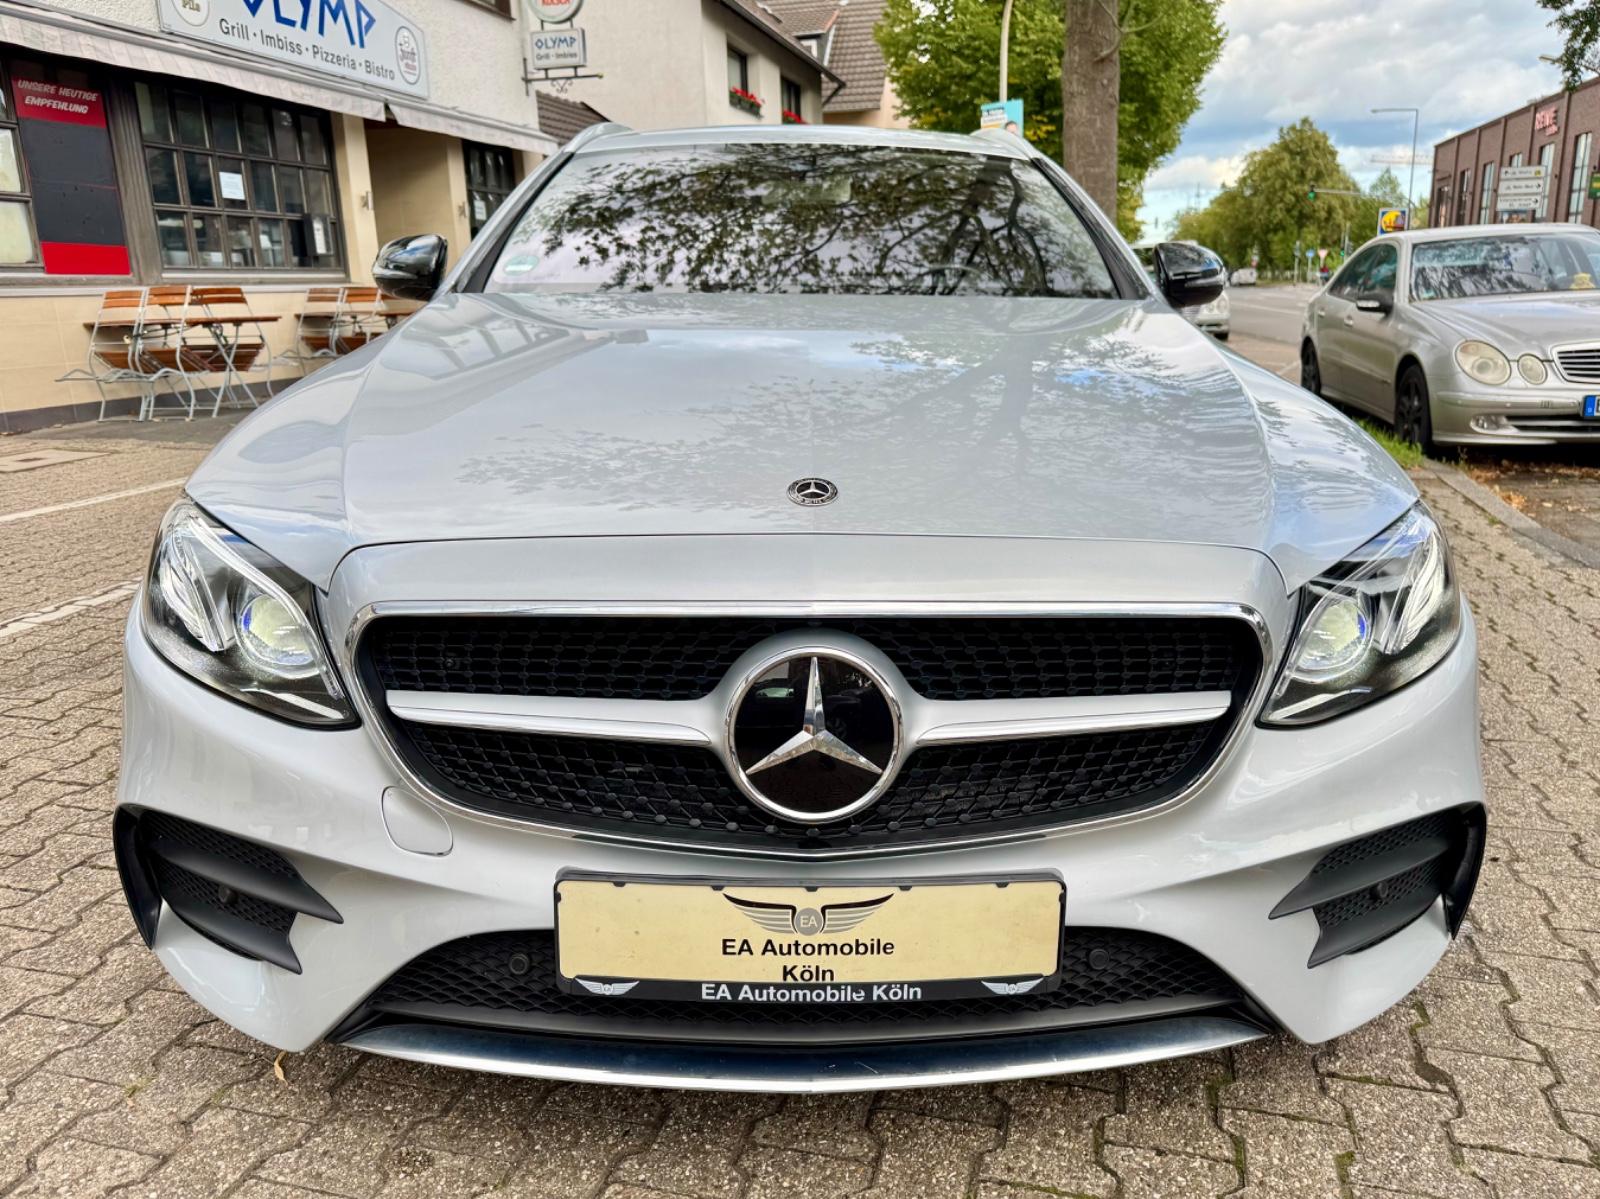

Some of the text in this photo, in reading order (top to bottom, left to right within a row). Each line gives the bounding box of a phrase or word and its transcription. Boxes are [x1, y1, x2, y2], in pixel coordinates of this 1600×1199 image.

[219, 18, 250, 41] Grill
[260, 29, 303, 55] Imbiss
[312, 44, 357, 70] Pizzeria
[364, 60, 396, 80] Bistro
[535, 36, 577, 49] OLYMP
[17, 79, 99, 102] UNSERE HEUTIGE
[24, 95, 89, 114] EMPFEHLUNG
[800, 916, 818, 928] EA
[721, 938, 895, 957] EA Automobile
[782, 965, 835, 982] Köln
[701, 983, 922, 1002] EA Automobile Köln
